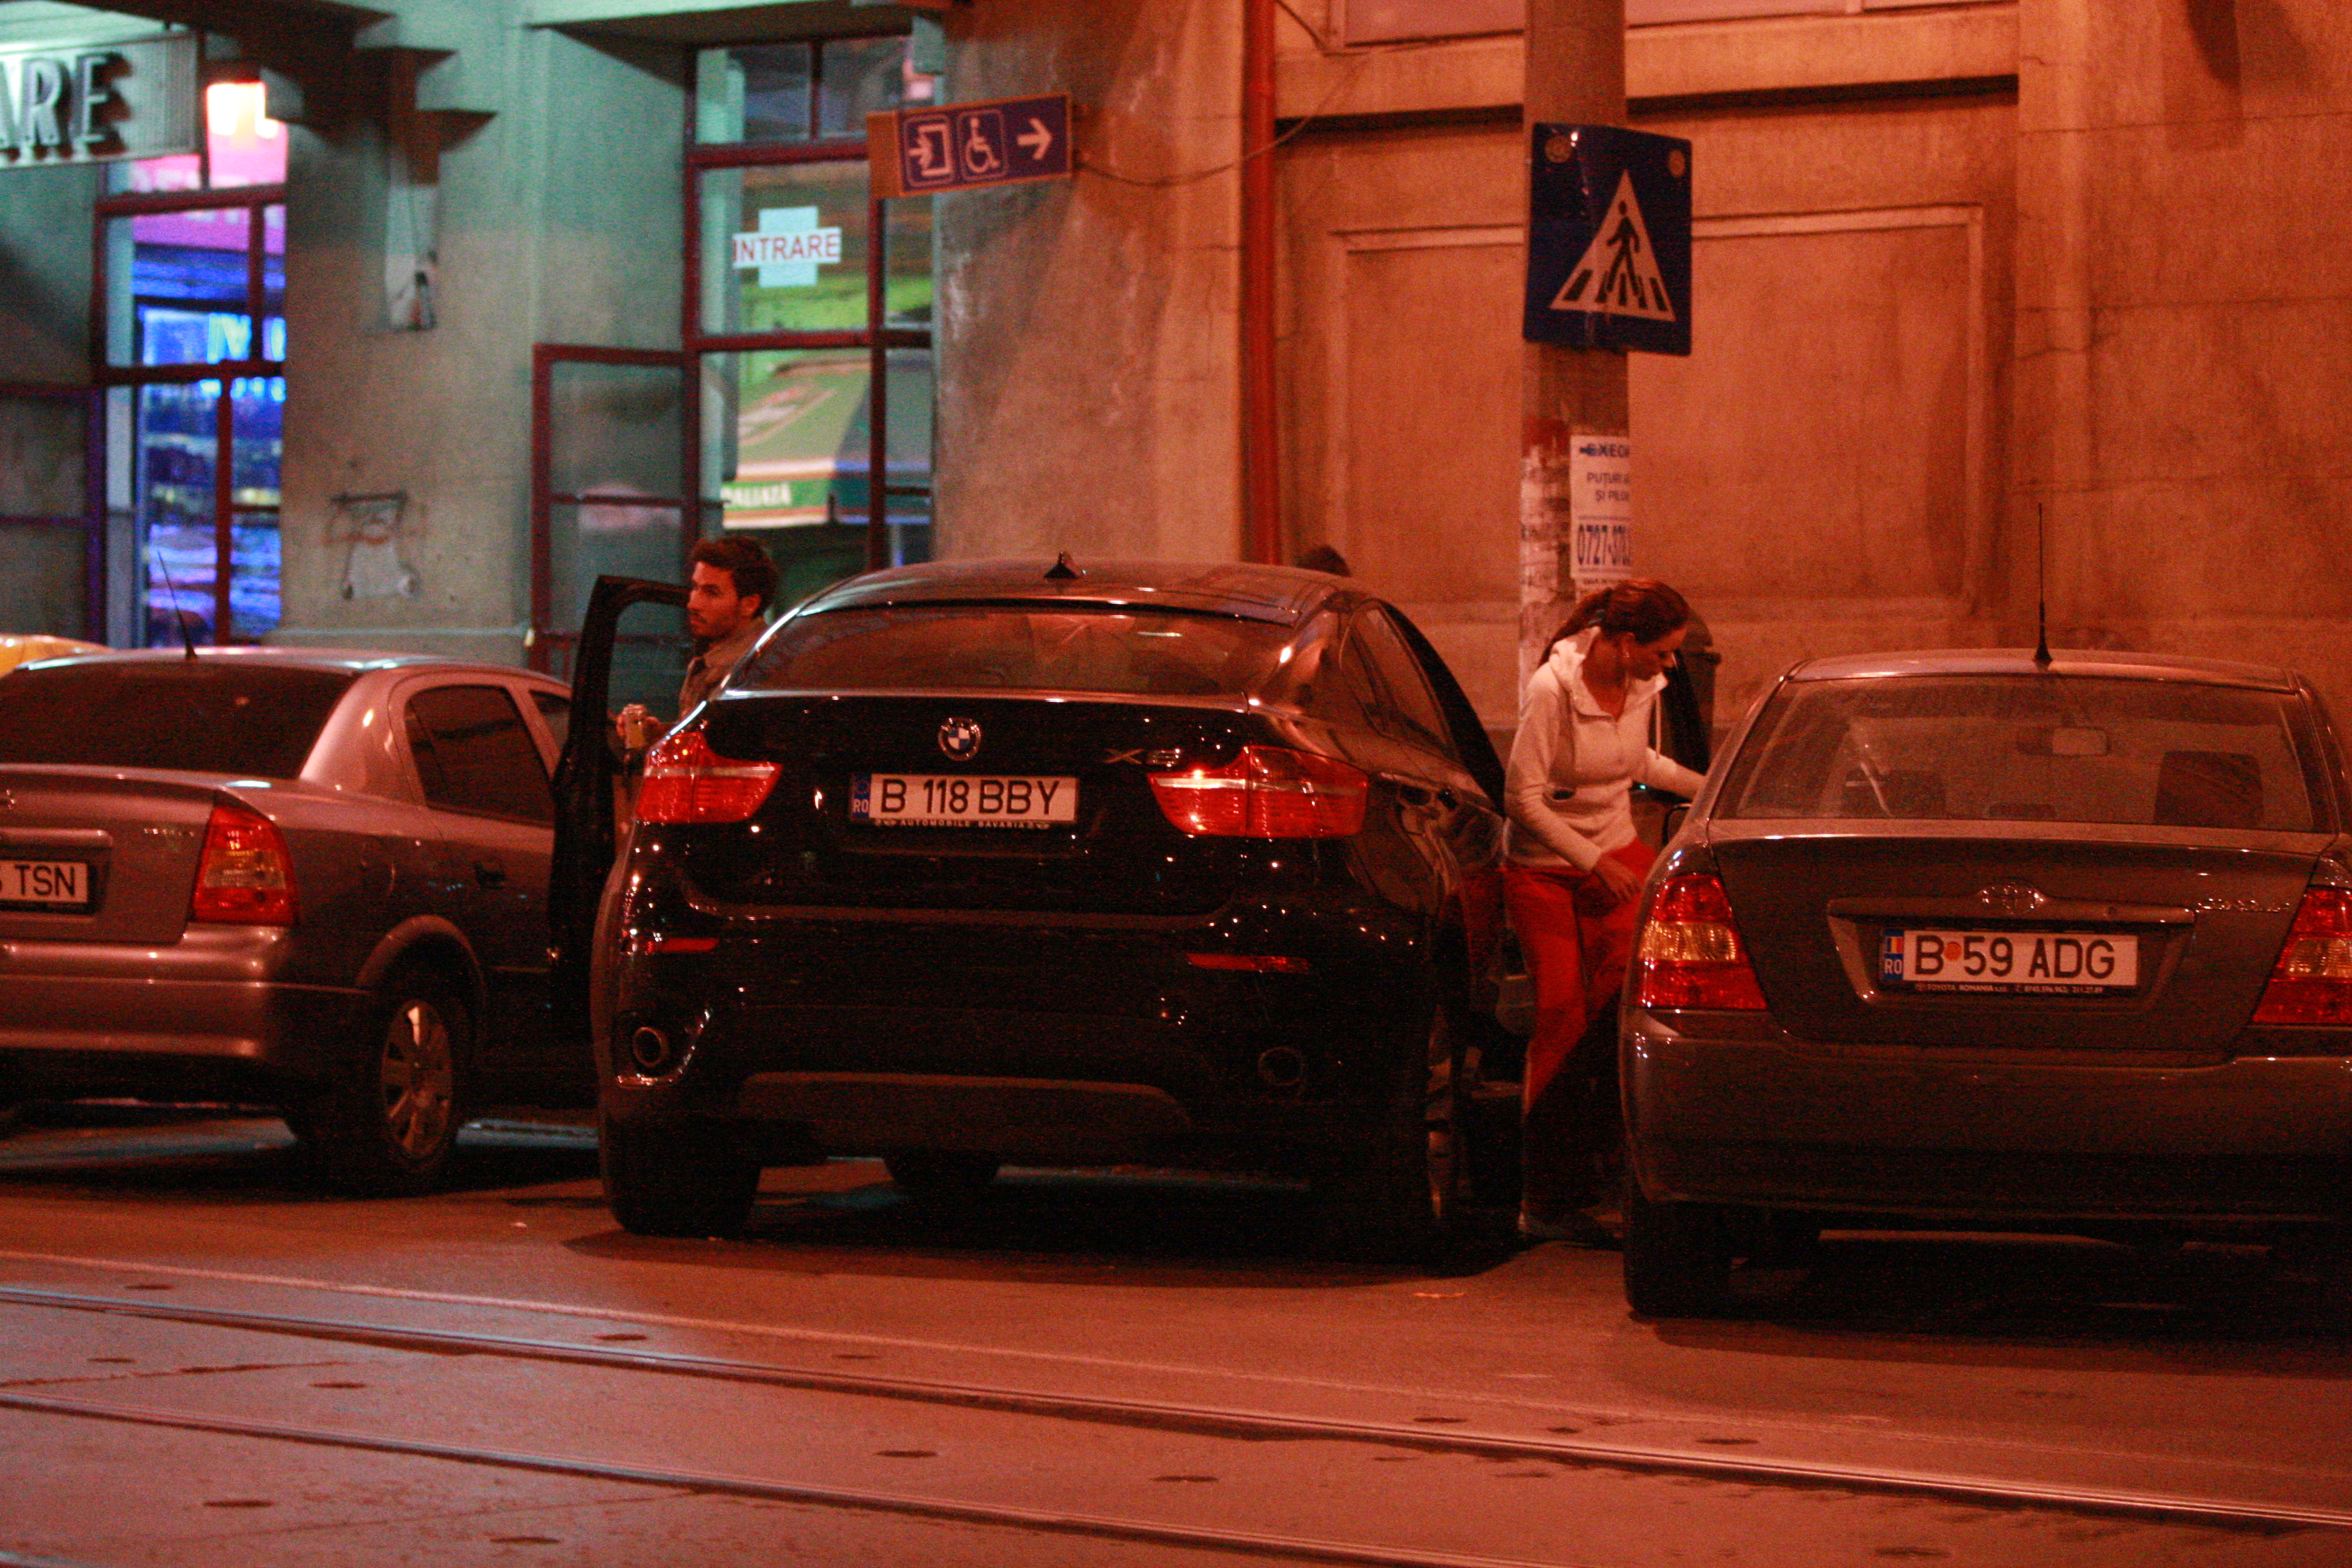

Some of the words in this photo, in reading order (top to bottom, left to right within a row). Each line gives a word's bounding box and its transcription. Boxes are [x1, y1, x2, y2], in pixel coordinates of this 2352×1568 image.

[733, 234, 841, 263] INTRARE
[853, 798, 869, 814] RO
[881, 779, 907, 813] B
[923, 779, 970, 814] 118
[978, 779, 1059, 815] BBY
[900, 819, 971, 828] AUTOMOBILE
[977, 820, 1025, 829] BAVARIA
[14, 864, 75, 896] TSN
[1884, 958, 1903, 975] RO
[1915, 935, 1945, 975] B
[1963, 936, 2014, 977] 59
[2028, 938, 2115, 979] ADG
